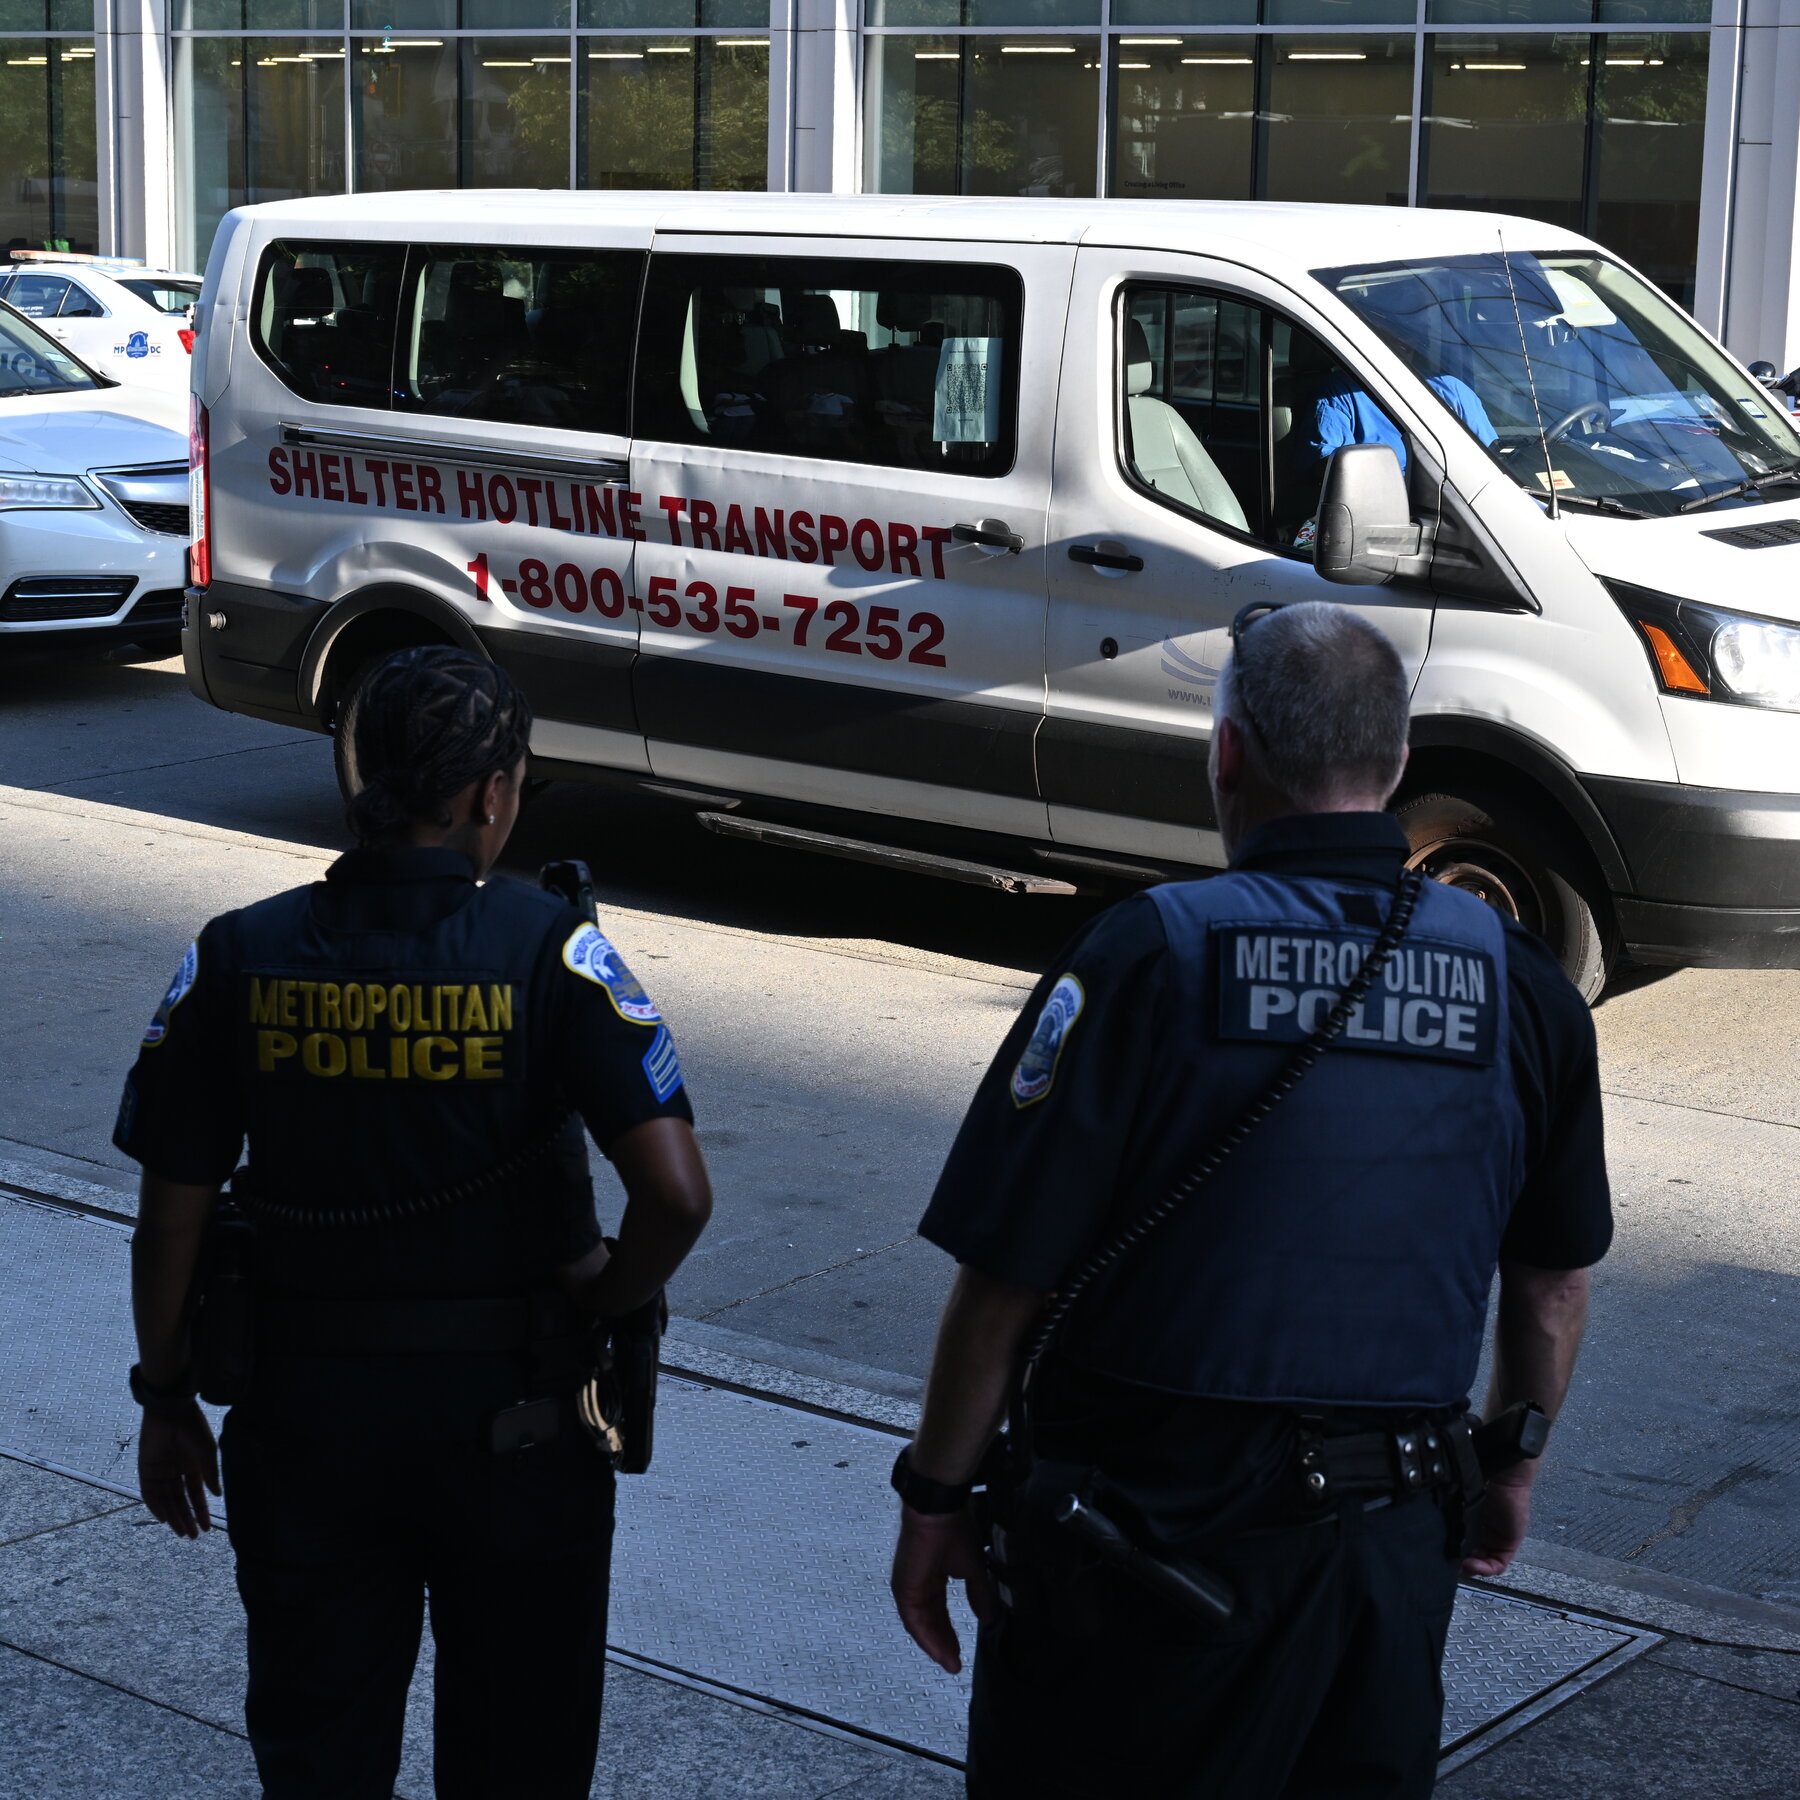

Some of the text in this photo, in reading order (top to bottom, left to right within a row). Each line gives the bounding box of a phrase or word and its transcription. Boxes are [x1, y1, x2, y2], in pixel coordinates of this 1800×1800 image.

[113, 346, 125, 354] MP
[150, 346, 161, 354] DC
[268, 446, 952, 580] SHELTER HOTLINE TRANSPORT
[467, 552, 947, 668] 1-800-535-7252
[250, 977, 513, 1033] METROPOLITAN
[257, 1029, 504, 1081] POLICE
